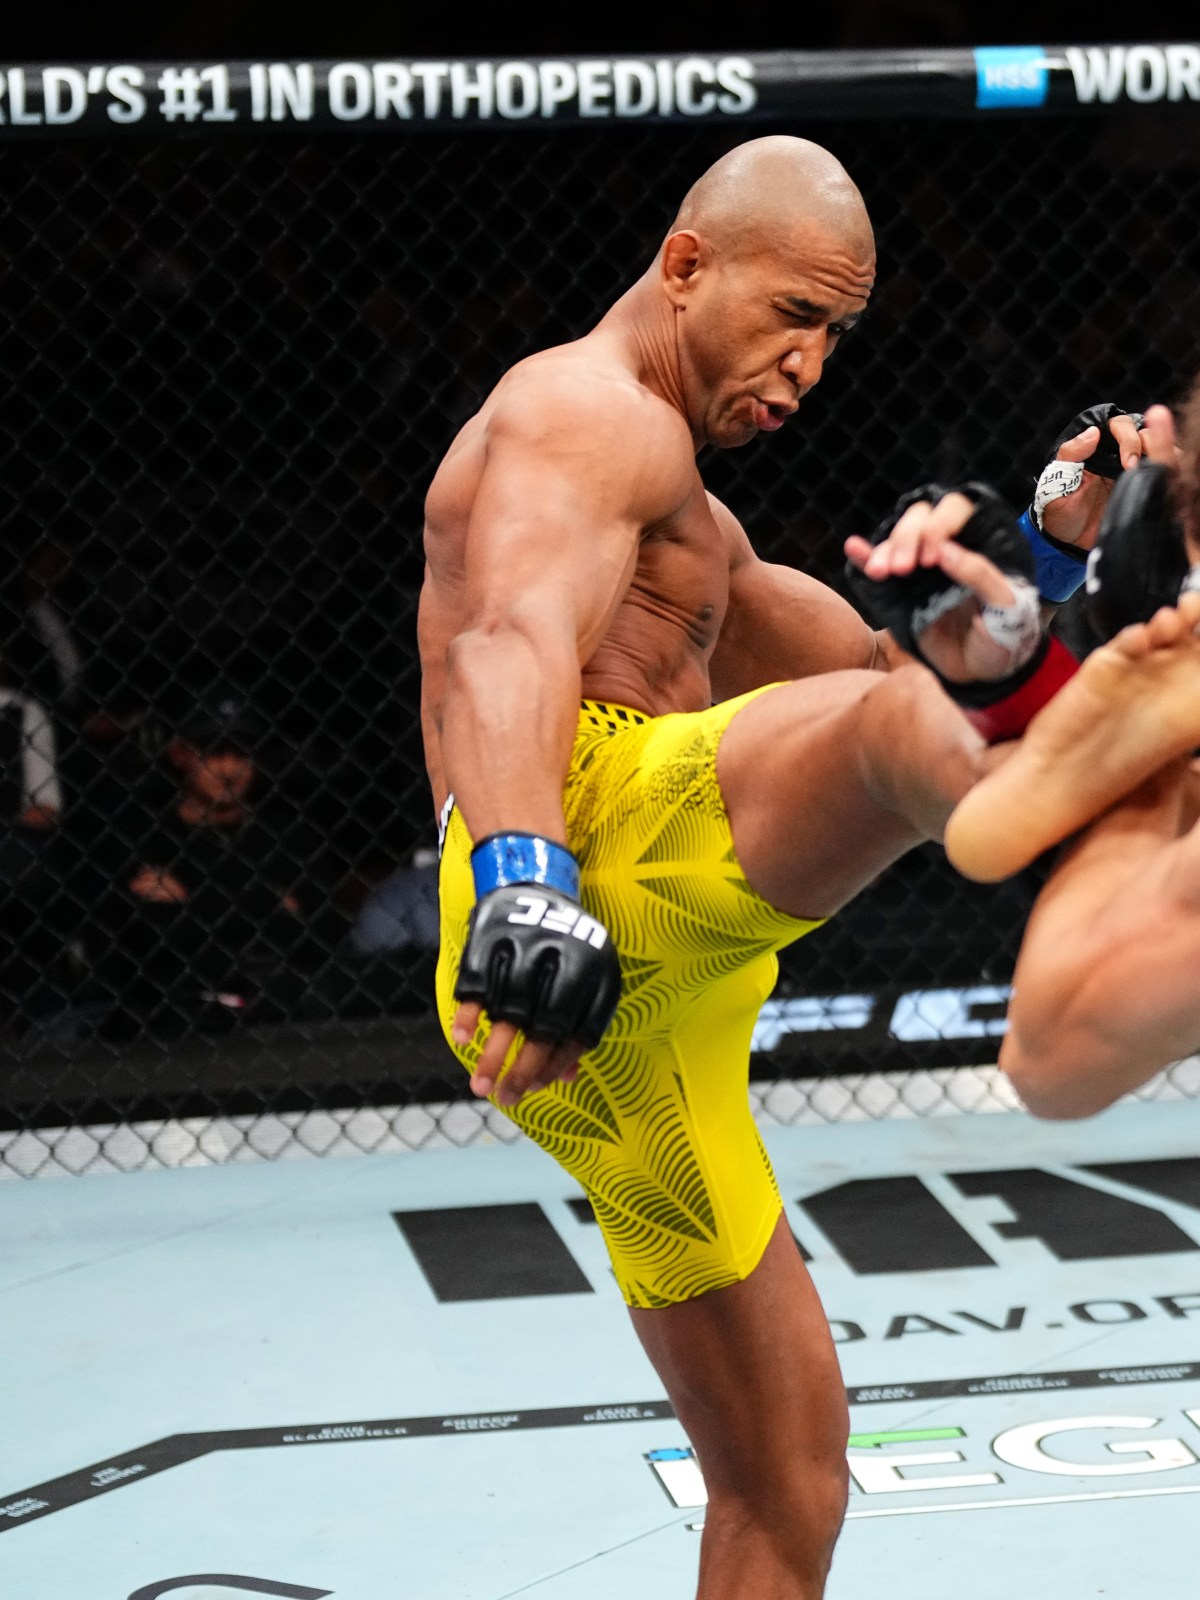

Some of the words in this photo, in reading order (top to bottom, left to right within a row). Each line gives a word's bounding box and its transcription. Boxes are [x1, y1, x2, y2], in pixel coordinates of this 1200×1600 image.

[0, 65, 147, 125] LD'S
[157, 64, 238, 122] #1
[249, 62, 314, 121] IN
[328, 57, 756, 121] ORTHOPEDICS
[507, 895, 608, 951] UFC
